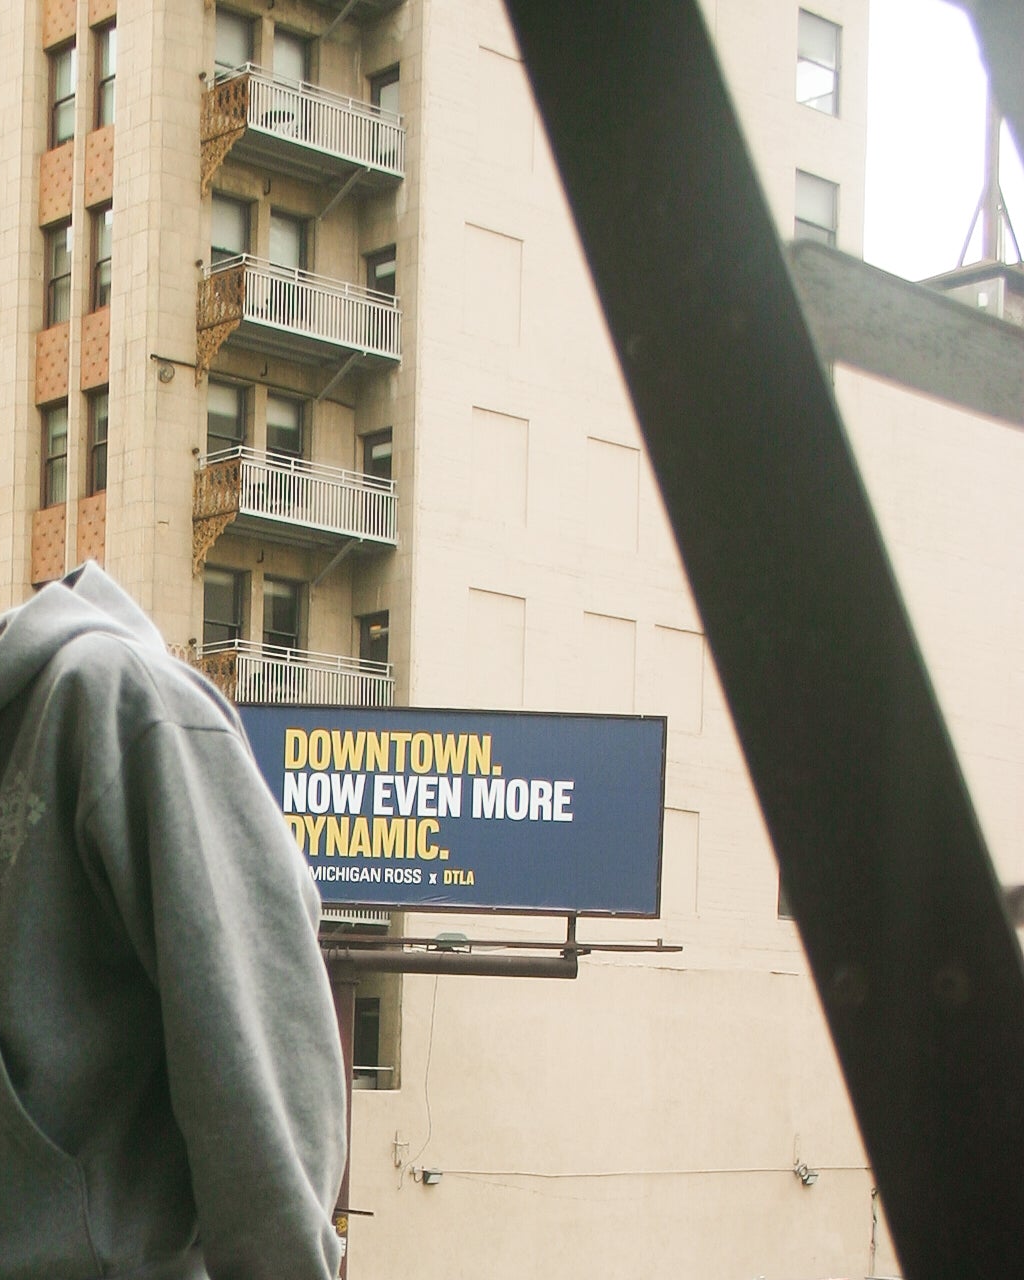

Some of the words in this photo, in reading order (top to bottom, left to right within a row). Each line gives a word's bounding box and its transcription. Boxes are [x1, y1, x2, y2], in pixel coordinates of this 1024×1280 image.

[284, 728, 502, 776] DOWNTOWN.
[283, 772, 366, 815] NOW
[375, 775, 464, 818] EVEN
[472, 778, 574, 822] MORE
[284, 814, 449, 860] DYNAMIC.
[309, 865, 381, 884] MICHIGAN
[384, 868, 422, 885] ROSS
[443, 869, 475, 886] DTLA
